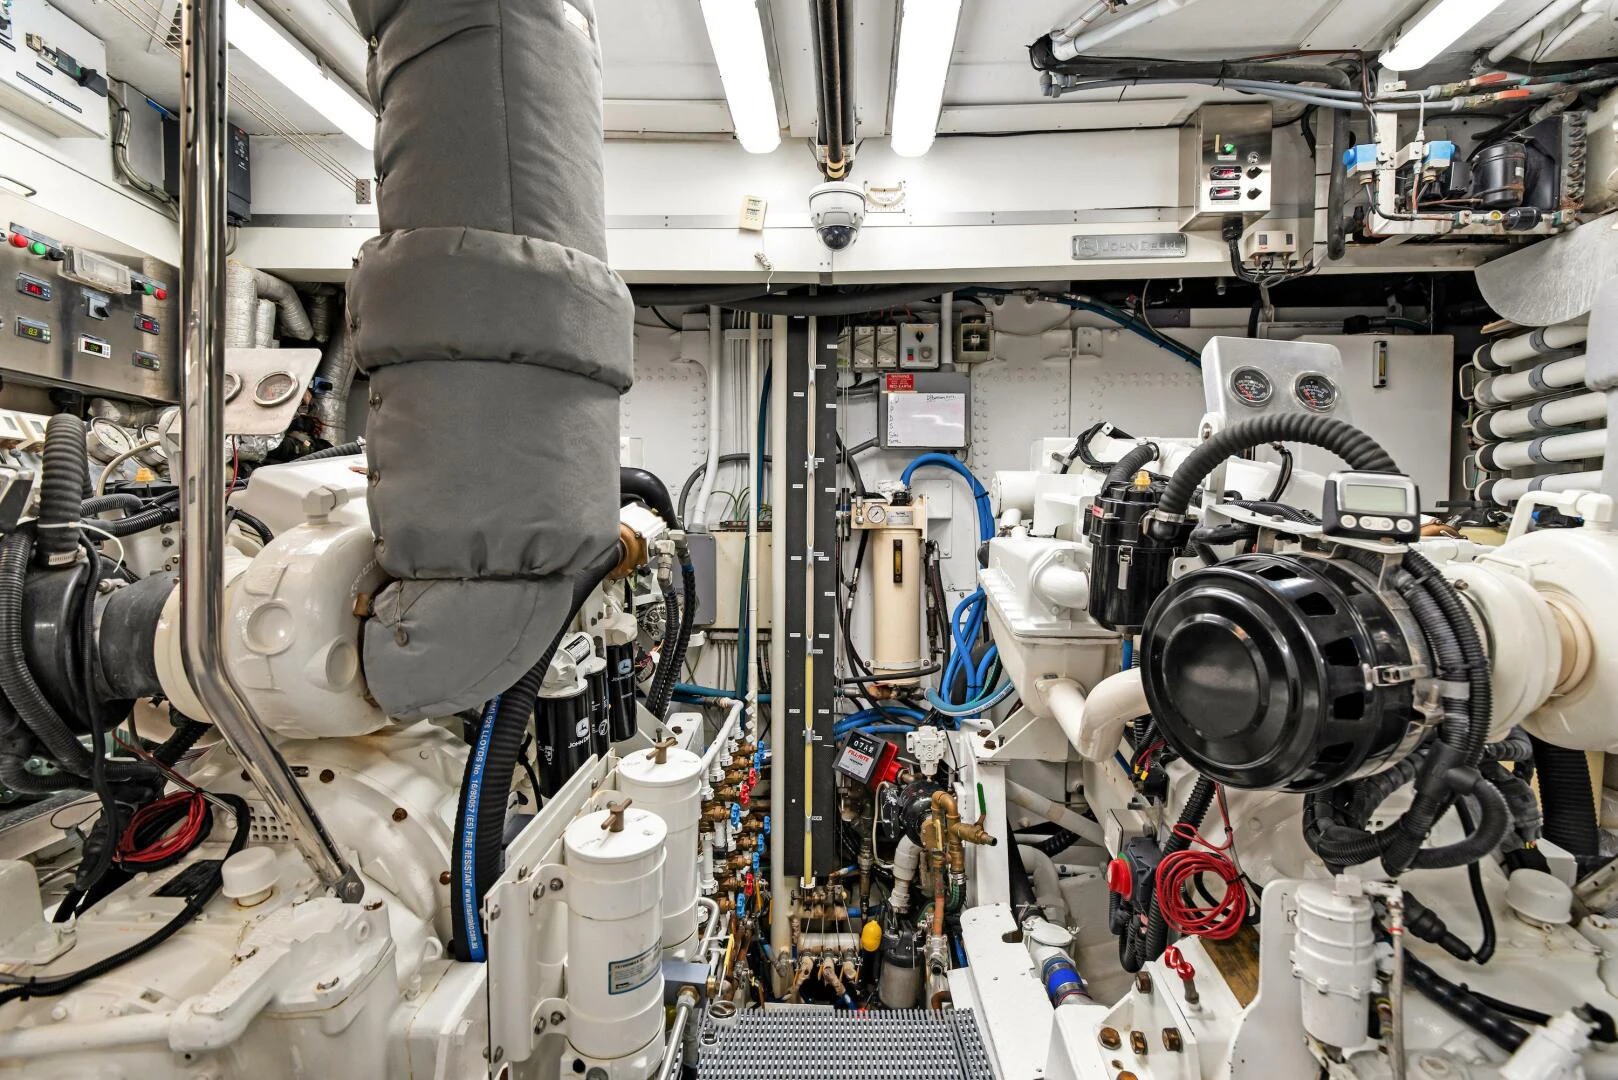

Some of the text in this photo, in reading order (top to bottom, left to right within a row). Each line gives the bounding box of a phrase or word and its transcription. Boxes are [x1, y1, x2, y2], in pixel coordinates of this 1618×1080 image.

[474, 728, 492, 763] LLOYDS
[463, 830, 474, 850] FIRE
[463, 851, 474, 888] RESISTANT
